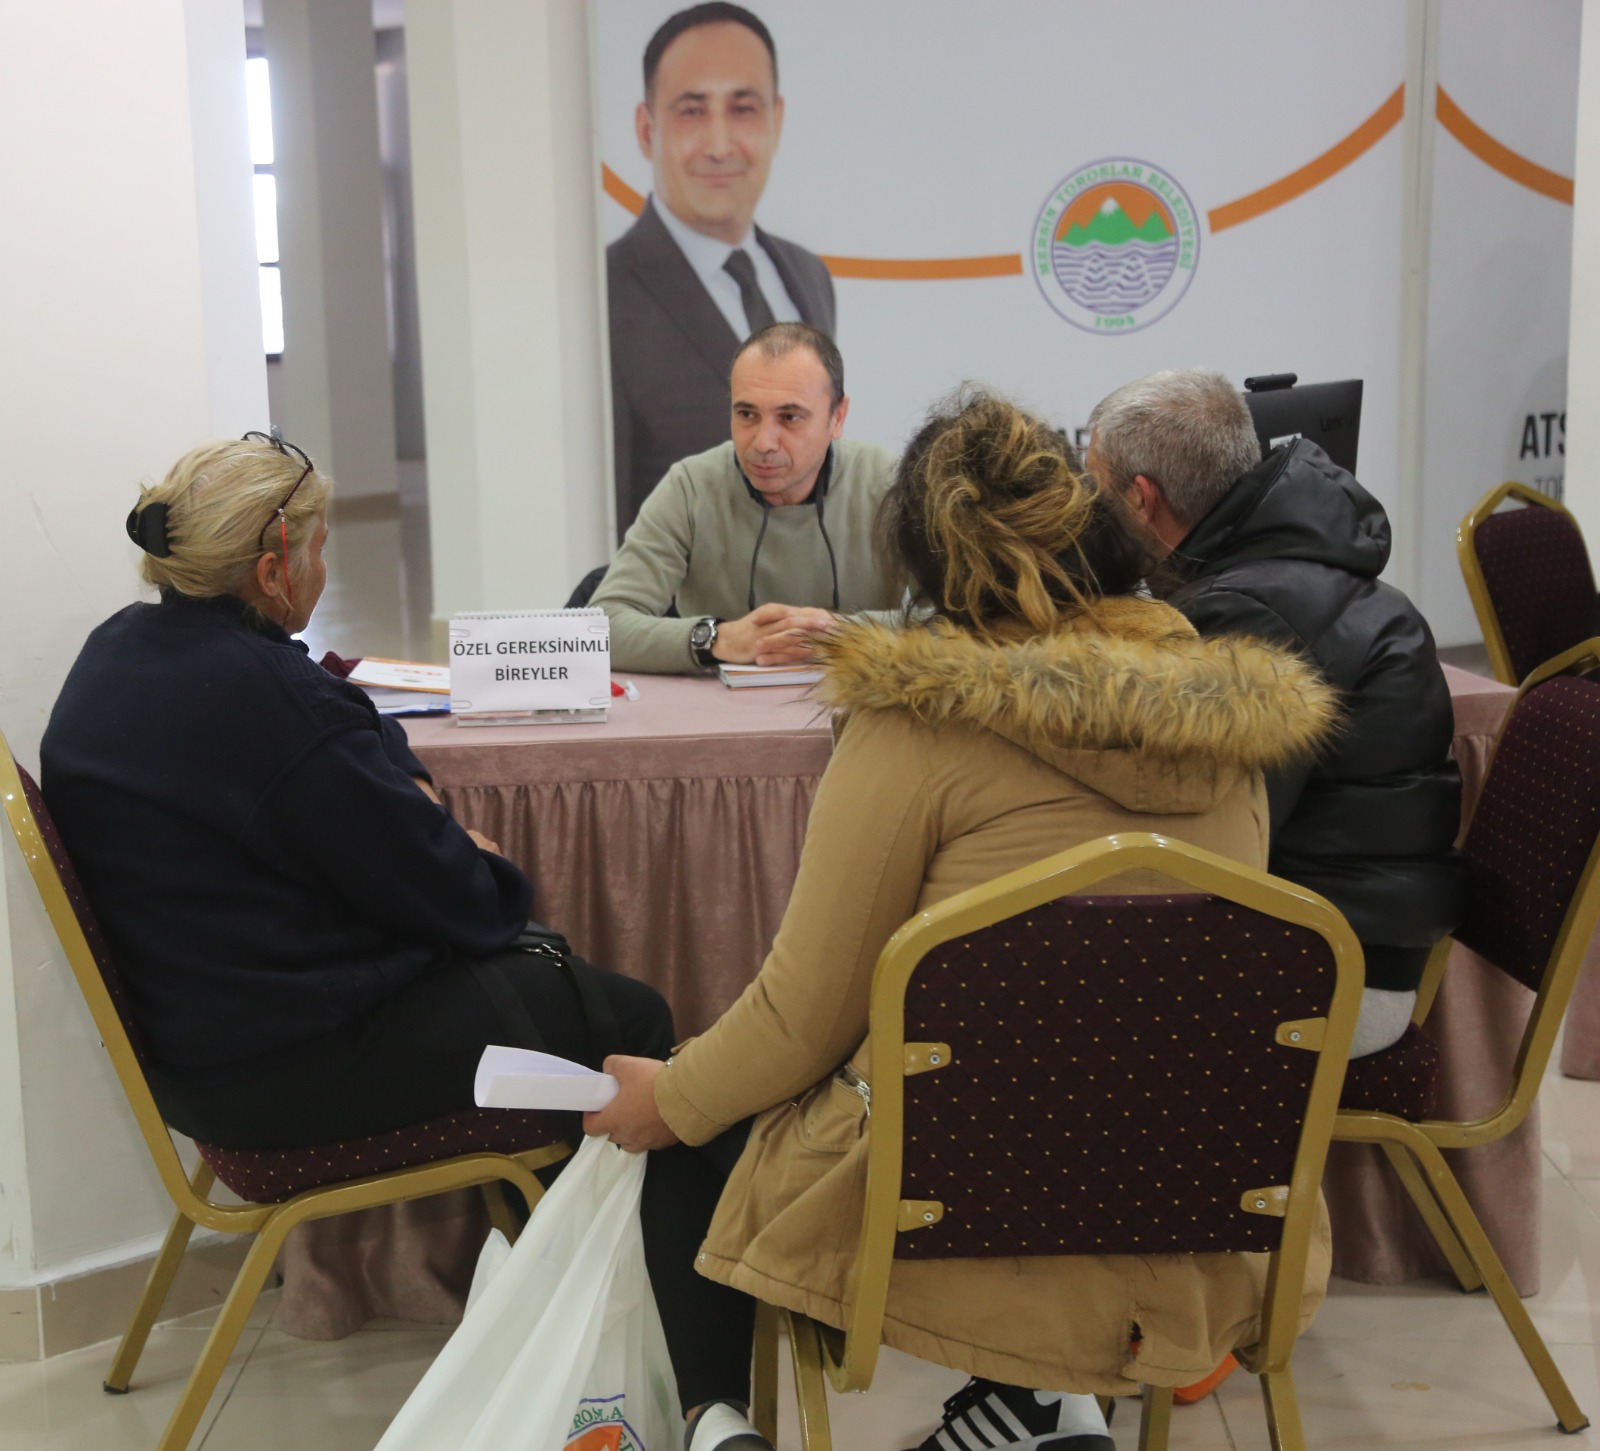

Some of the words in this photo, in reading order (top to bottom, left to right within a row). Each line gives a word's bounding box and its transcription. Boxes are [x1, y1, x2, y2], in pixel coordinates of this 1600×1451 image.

[1056, 164, 1144, 205] TOROSLAR
[453, 640, 492, 656] ÖZEL
[497, 636, 609, 655] GEREKSİNİMLİ
[495, 665, 568, 681] BİREYLER
